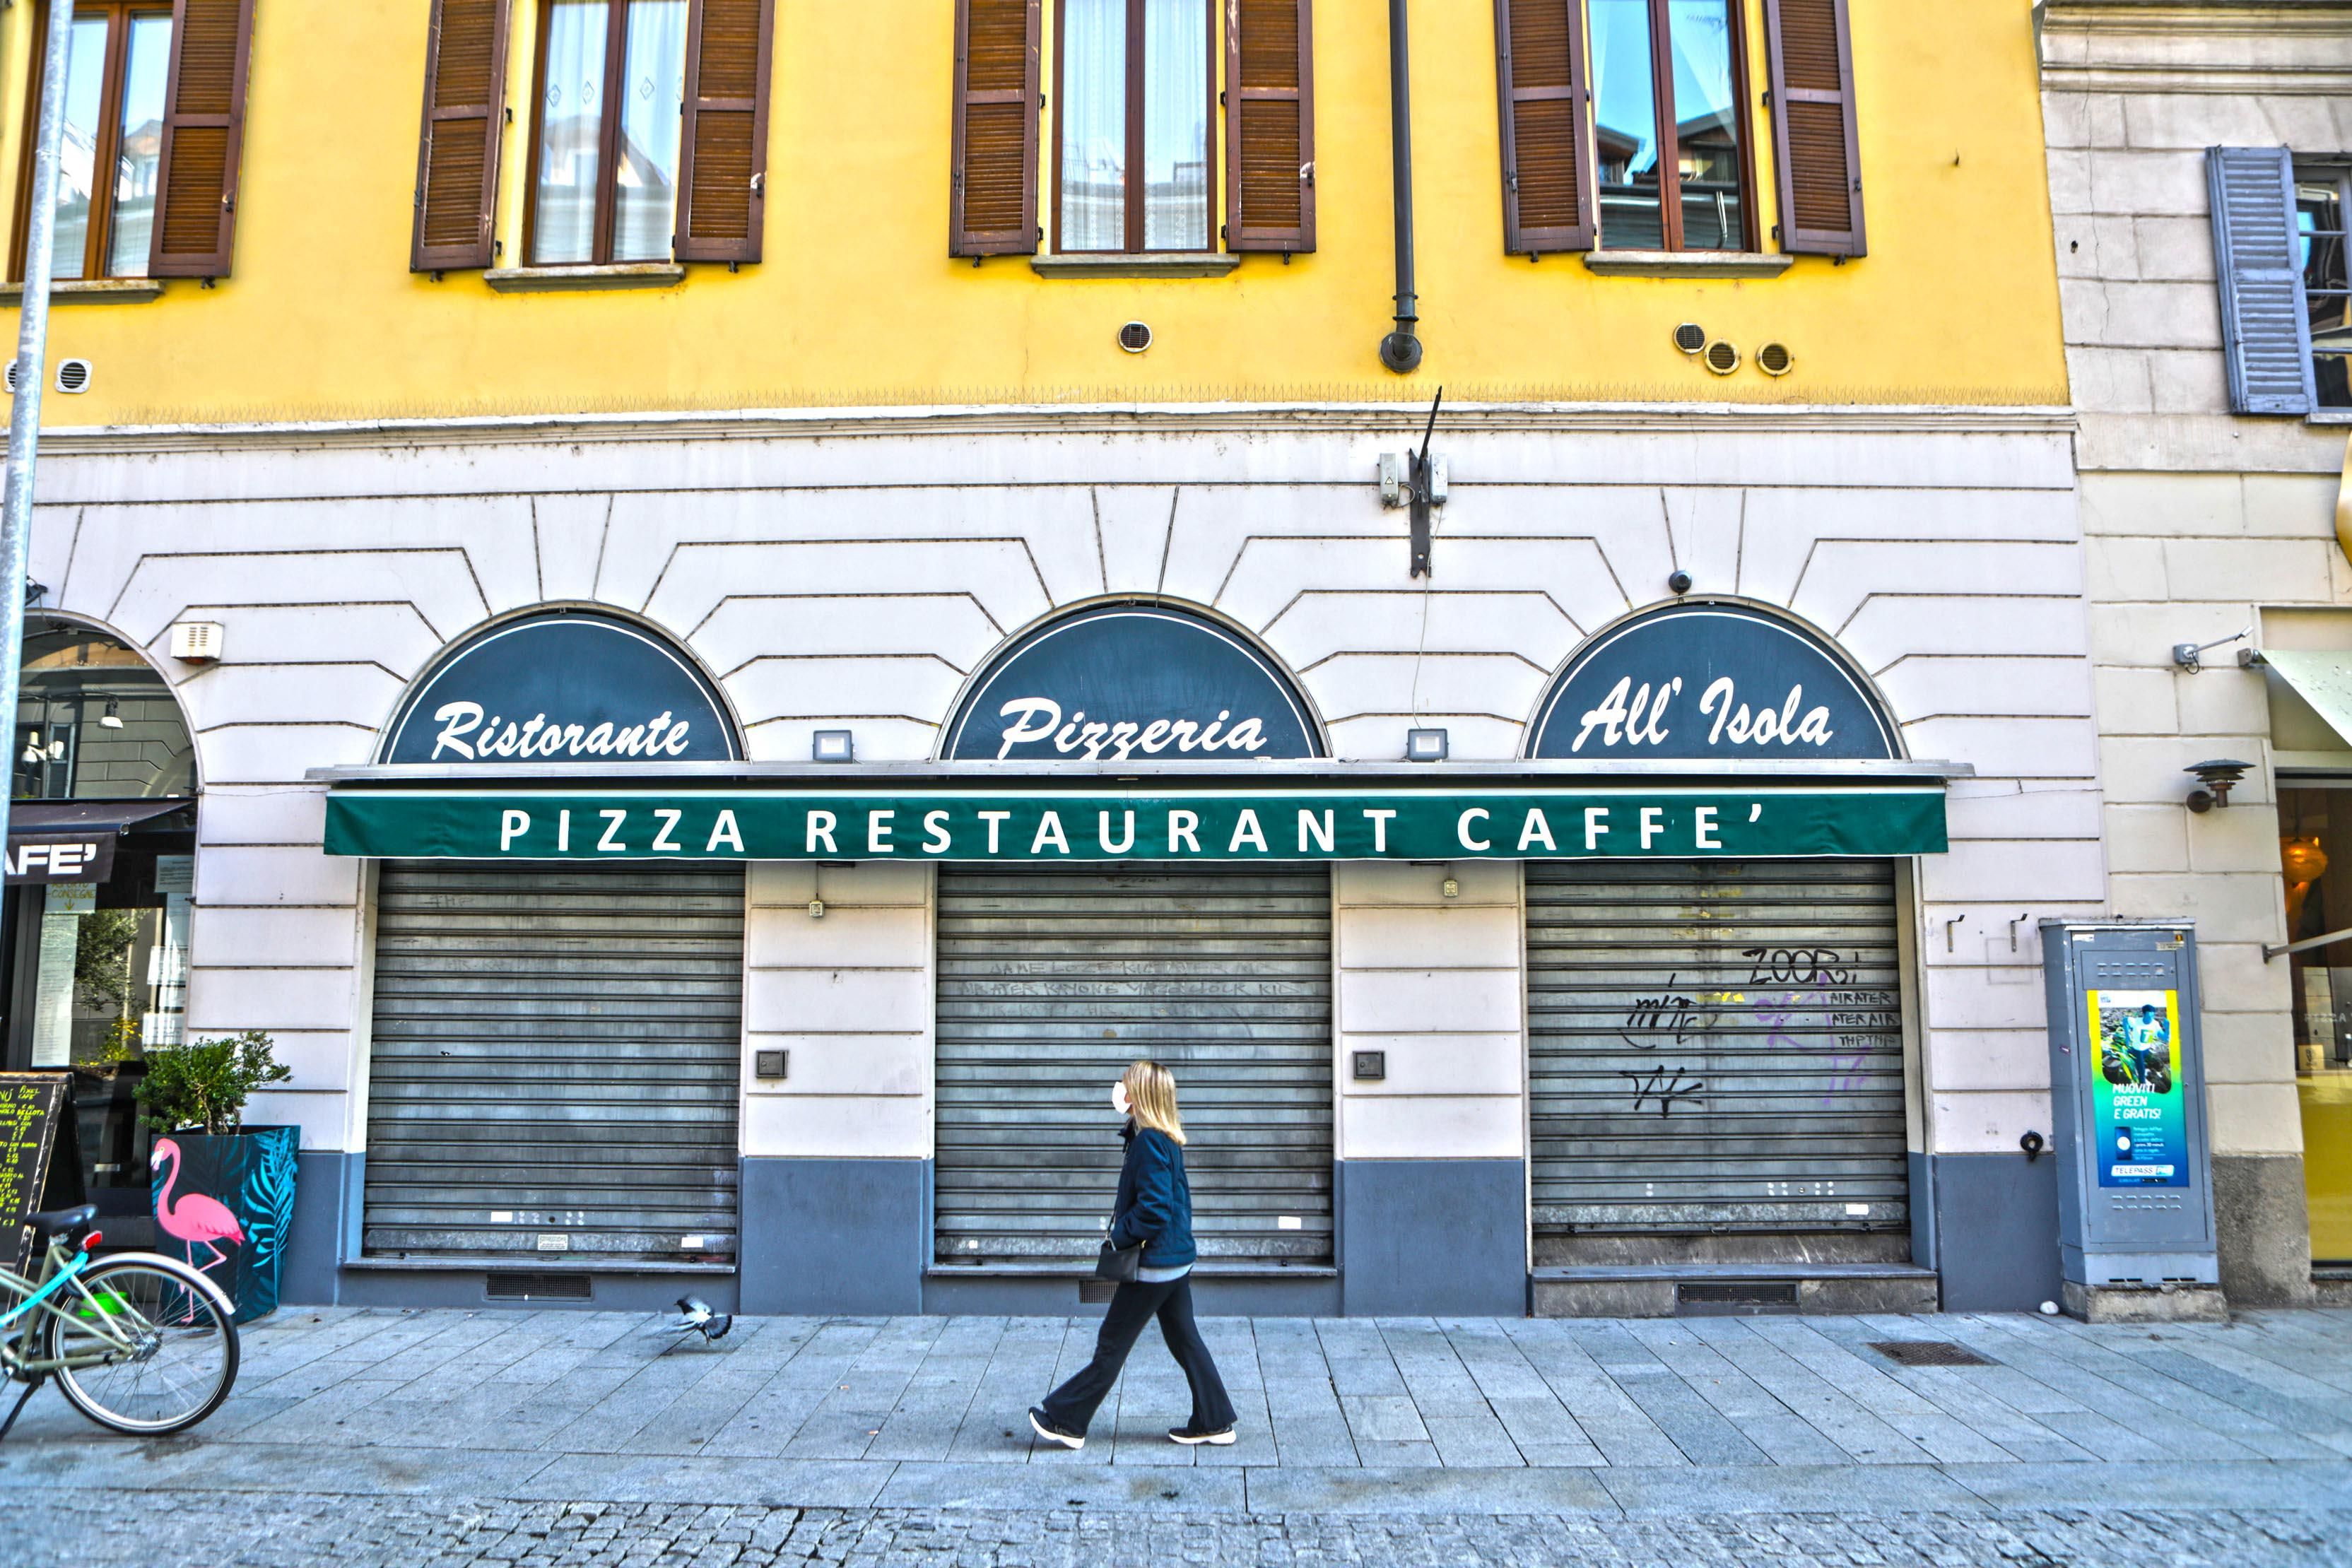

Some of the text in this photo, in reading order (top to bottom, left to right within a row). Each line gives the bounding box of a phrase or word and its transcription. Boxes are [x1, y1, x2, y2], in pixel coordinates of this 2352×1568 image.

[430, 701, 690, 760] Ristorante
[997, 697, 1267, 760] Pizzeria
[1572, 676, 1833, 753] All' Isola
[500, 809, 745, 852] PIZZA
[806, 808, 1396, 854] RESTAURANT
[2112, 1083, 2156, 1094] MUOVITI
[2113, 1096, 2148, 1107] GREEN
[2114, 1108, 2162, 1119] E GRATIS!
